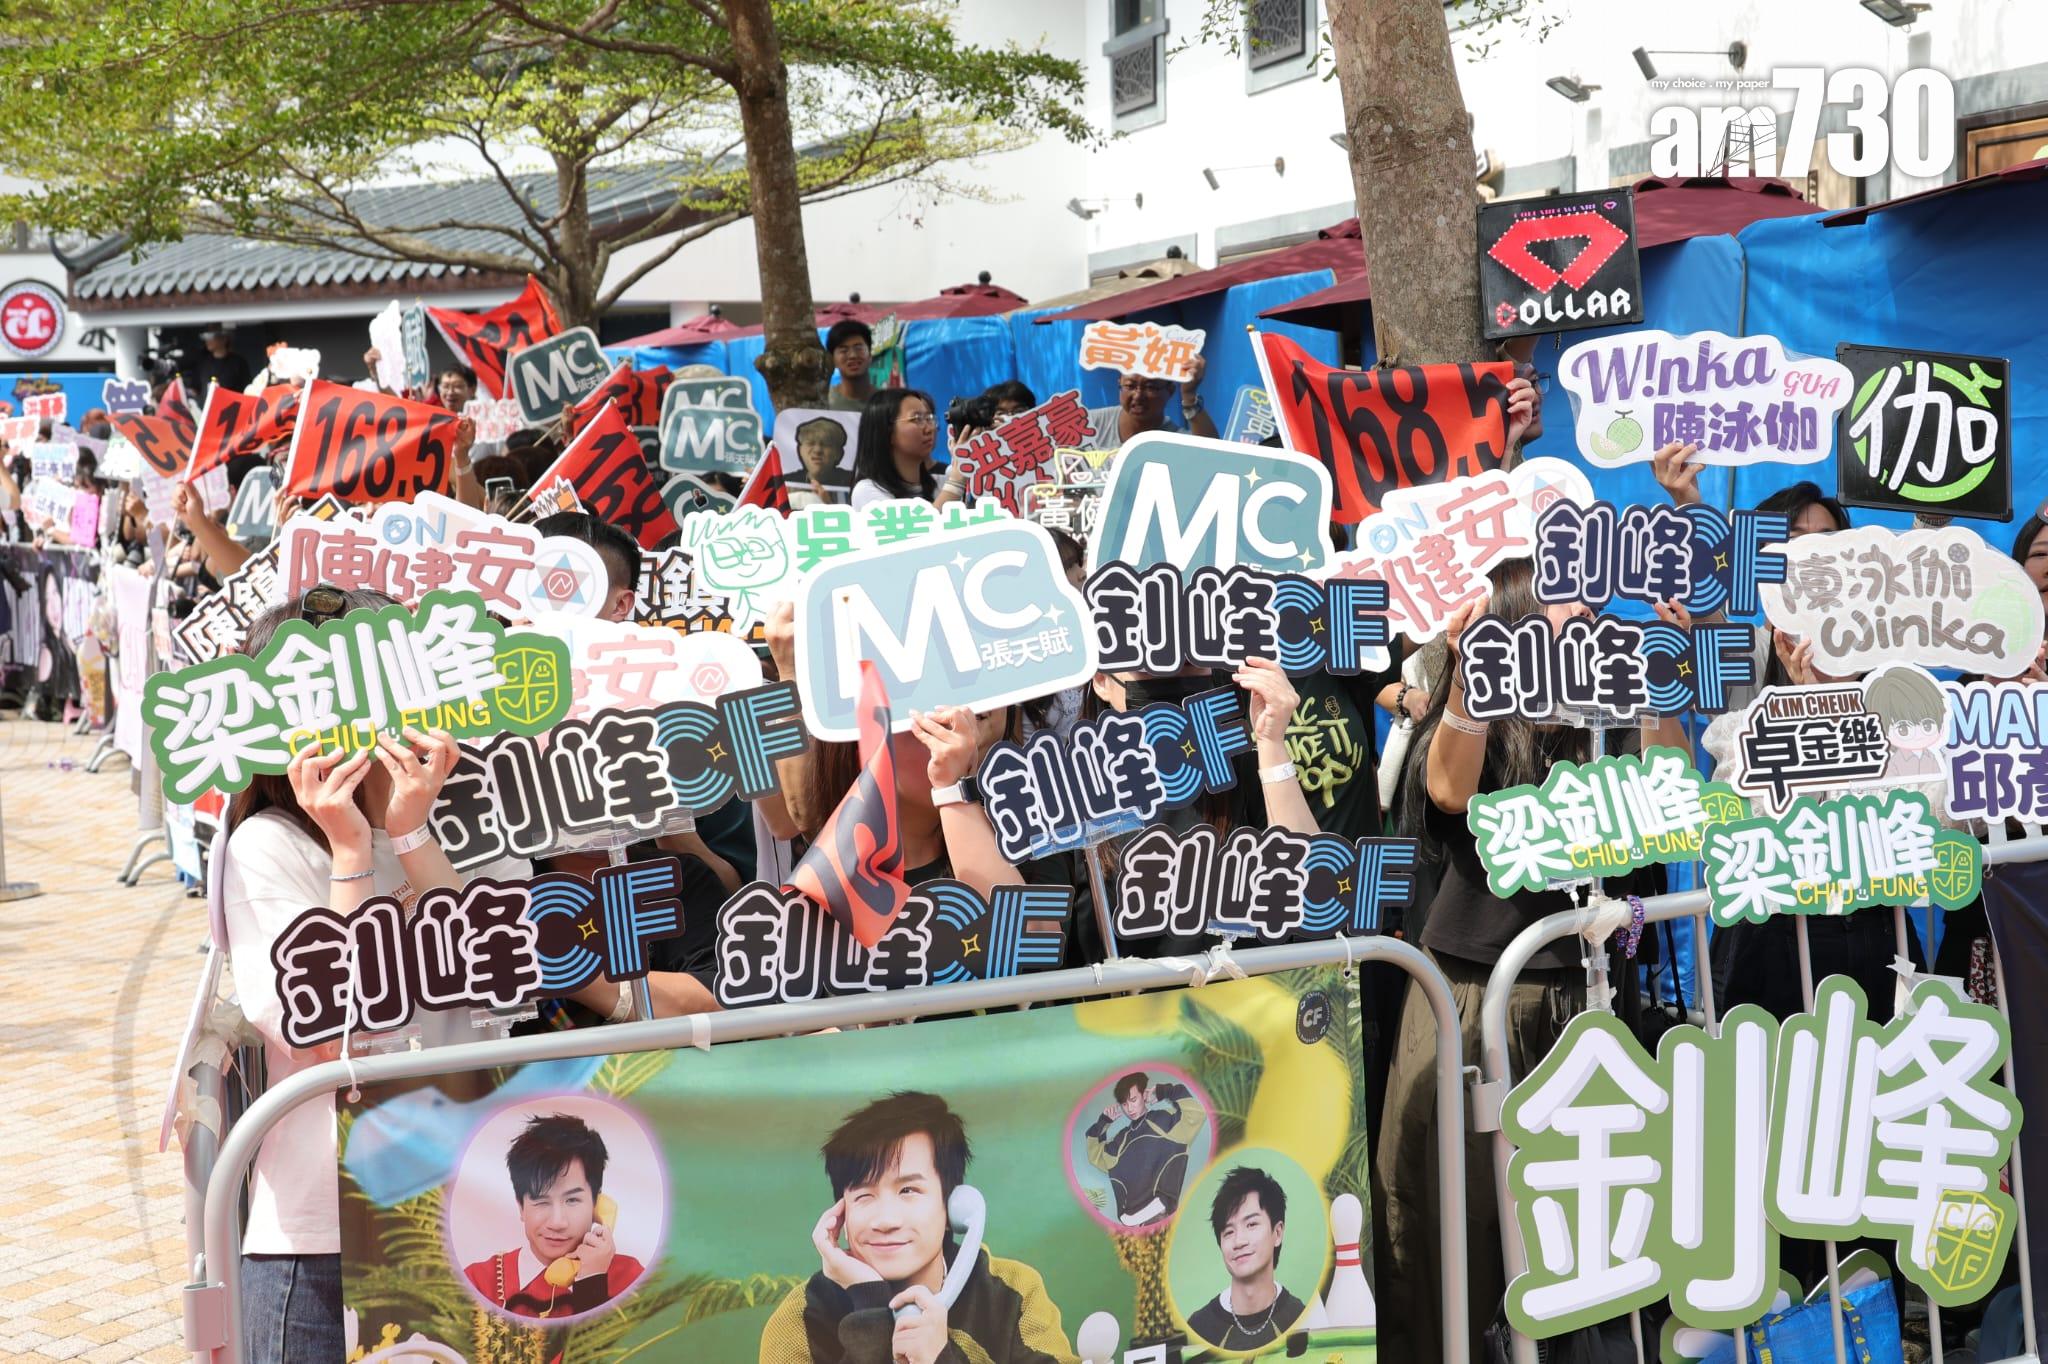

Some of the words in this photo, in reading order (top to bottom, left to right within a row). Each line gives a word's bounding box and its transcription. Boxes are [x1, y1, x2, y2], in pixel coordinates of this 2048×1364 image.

[521, 340, 596, 411] MC
[1086, 325, 1196, 377] 黃妍
[1783, 371, 1840, 399] GUA
[314, 403, 456, 497] 168.5
[673, 416, 753, 461] MC
[1654, 401, 1818, 453] 陳泳伽
[1850, 361, 1998, 491] 伽
[383, 513, 448, 546] ON
[797, 503, 1006, 573] 吳業
[1119, 461, 1308, 572] MC
[832, 549, 1044, 701] MC
[980, 626, 1074, 671] 張天賦
[1768, 696, 1805, 719] KIM
[1806, 693, 1862, 717] CHEUK
[1745, 711, 1886, 806] 卓金樂
[1570, 843, 1629, 870] CHIU
[1642, 831, 1701, 854] FUNG
[1870, 877, 1929, 898] FUNG
[1302, 1006, 1323, 1028] CF
